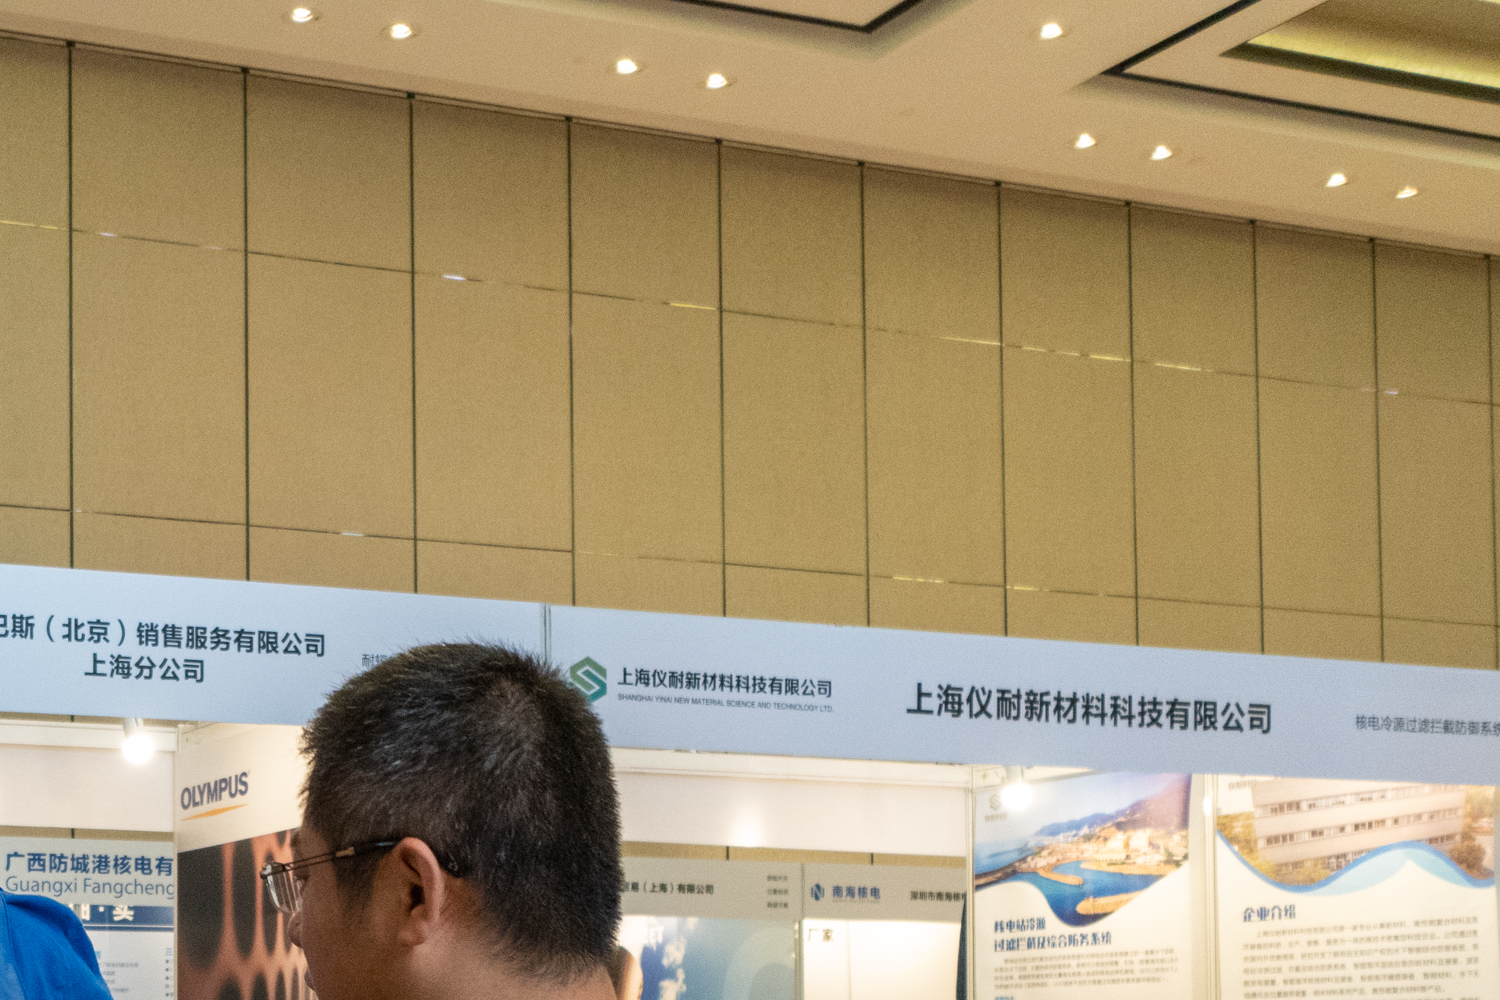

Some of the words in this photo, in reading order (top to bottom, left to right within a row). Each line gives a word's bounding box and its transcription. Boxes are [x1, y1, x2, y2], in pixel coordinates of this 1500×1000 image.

[84, 653, 206, 683] 上海分公司
[617, 667, 832, 698] 上海仪耐新材料科技有限公司
[617, 693, 653, 702] SHANGHAI
[691, 697, 725, 707] MATERIAL
[726, 699, 756, 708] SCIENCE
[757, 701, 772, 709] AND
[773, 702, 818, 712] TECHNOLOGY
[906, 681, 1272, 735] 上海仪耐新材料科技有限公司
[180, 770, 249, 811] OLYMPUS
[5, 851, 174, 877] 广西防城港核电有
[5, 875, 78, 897] Guangxi
[832, 885, 881, 900] 南海核电
[1243, 904, 1296, 922] 企业介绍
[808, 928, 833, 942] 厂家
